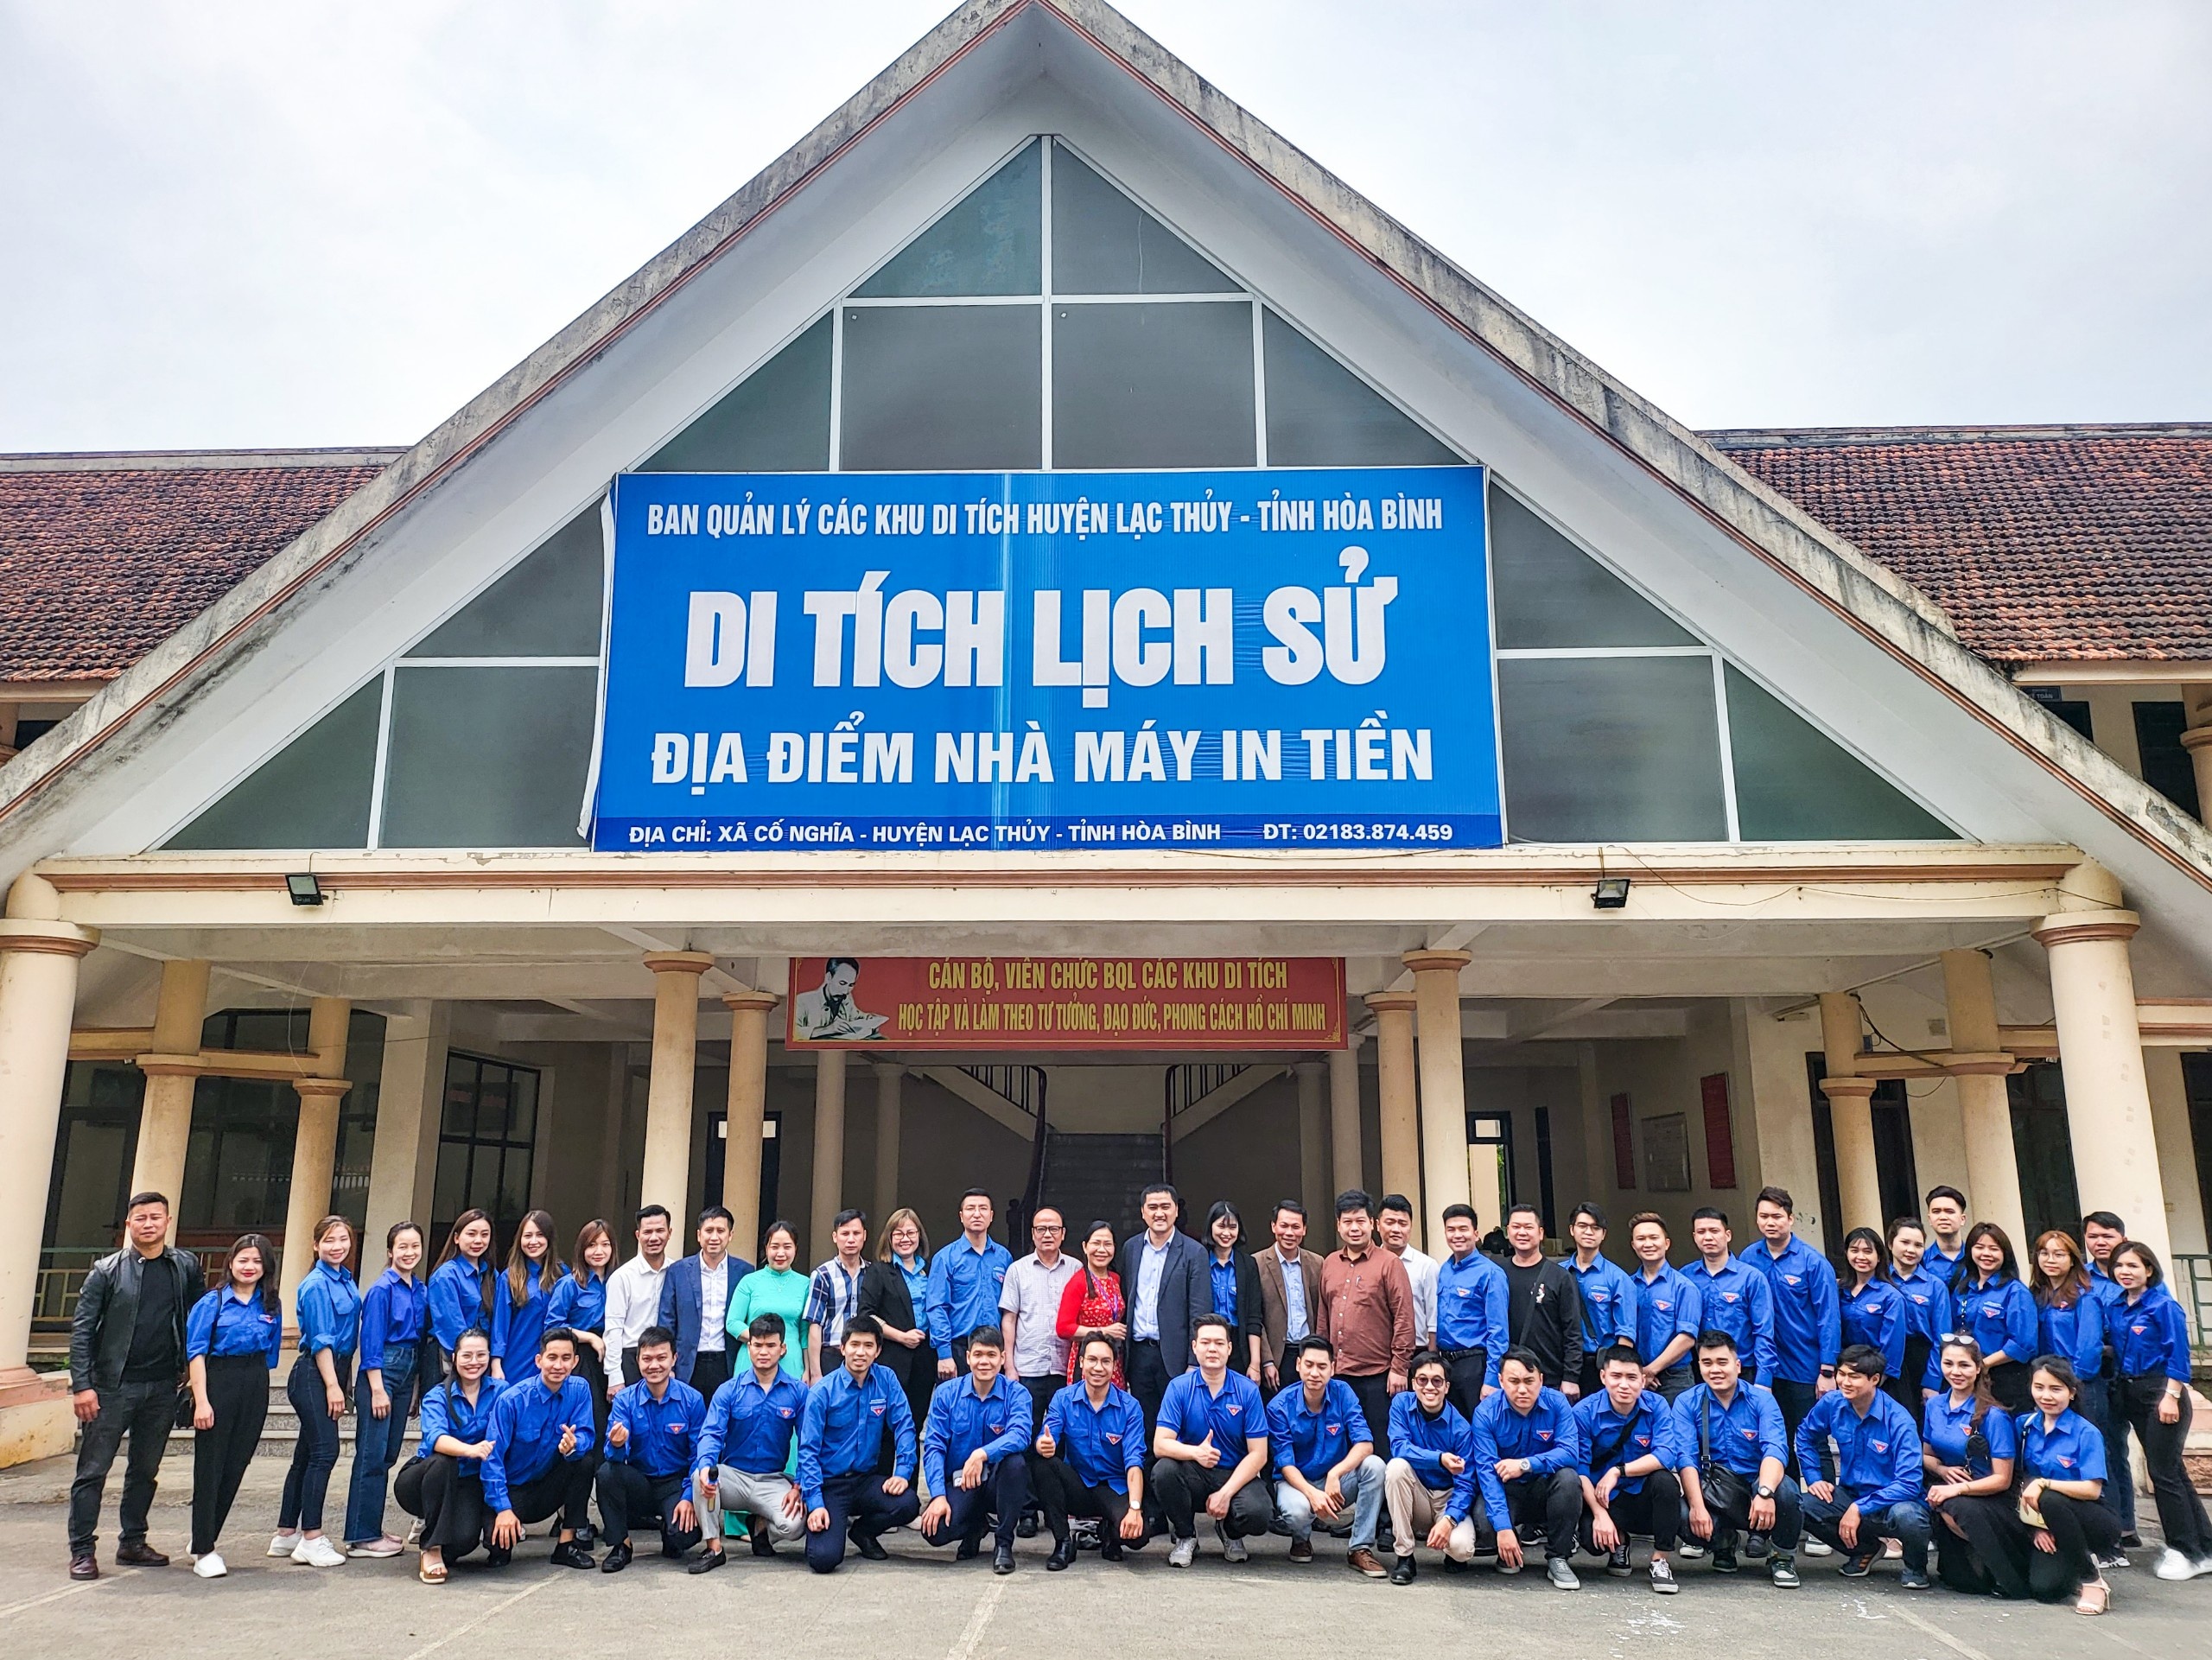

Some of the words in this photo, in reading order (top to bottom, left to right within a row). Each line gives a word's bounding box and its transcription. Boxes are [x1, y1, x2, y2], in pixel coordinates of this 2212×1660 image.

[647, 503, 699, 536] BAN
[706, 491, 774, 540] QUẢN
[782, 497, 810, 535] LÝ
[817, 497, 868, 535] CÁC
[874, 502, 925, 535] KHU
[931, 503, 958, 535] DI
[964, 497, 1020, 535] TÍCH
[1027, 496, 1109, 541] HUYỆN
[1116, 501, 1163, 540] LẠC
[1170, 488, 1233, 533] THỦY
[1257, 488, 1315, 532] TỈNH
[1323, 492, 1375, 531] HÒA
[1382, 492, 1443, 531] BÌNH
[683, 590, 778, 688] DI
[803, 570, 1005, 689] TÍCH
[1033, 587, 1234, 709] LỊCH
[1262, 545, 1399, 686] SỬ
[651, 732, 749, 796] ĐỊA
[766, 710, 914, 784] ĐIỂM
[934, 721, 1055, 784] NHÀ
[1074, 719, 1203, 783] MÁY
[1222, 728, 1282, 781] IN
[1300, 709, 1433, 781] TIỀN
[628, 825, 666, 848] ĐỊA
[671, 819, 711, 843] CHỈ:
[717, 822, 748, 843] XÃ
[753, 817, 785, 843] CỐ
[789, 821, 855, 843] NGHĨA
[873, 821, 942, 848] HUYỆN
[949, 824, 989, 847] LẠC
[995, 817, 1051, 843] THỦY
[1068, 818, 1116, 842] TỈNH
[1122, 819, 1167, 842] HÒA
[1172, 819, 1222, 841] BÌNH
[1262, 824, 1297, 841] ĐT:
[1303, 824, 1453, 841] 02183.874.459
[929, 957, 966, 989] CÁN
[1005, 957, 1046, 989] VIÊN
[1051, 957, 1098, 989] CHỨC
[1103, 962, 1137, 991] BQL
[1141, 957, 1178, 989] CÁC
[1183, 962, 1219, 989] KHU
[1224, 962, 1243, 989] DI
[1247, 957, 1287, 989] TÍCH
[898, 1002, 924, 1037] HỌC
[926, 997, 951, 1037] TẬP
[953, 997, 969, 1031] VÀ
[973, 997, 1000, 1031] LÀM
[1002, 1002, 1034, 1031] THEO
[1037, 1000, 1055, 1031] TƯ
[1056, 991, 1100, 1034] TƯỞNG,
[1103, 1002, 1129, 1037] ĐẠO
[1132, 995, 1161, 1034] ĐỨC,
[1163, 1002, 1206, 1031] PHONG
[1210, 997, 1243, 1031] CÁCH
[1246, 993, 1264, 1031] HỒ
[1267, 997, 1289, 1031] CHÍ
[1291, 1002, 1326, 1031] MINH
